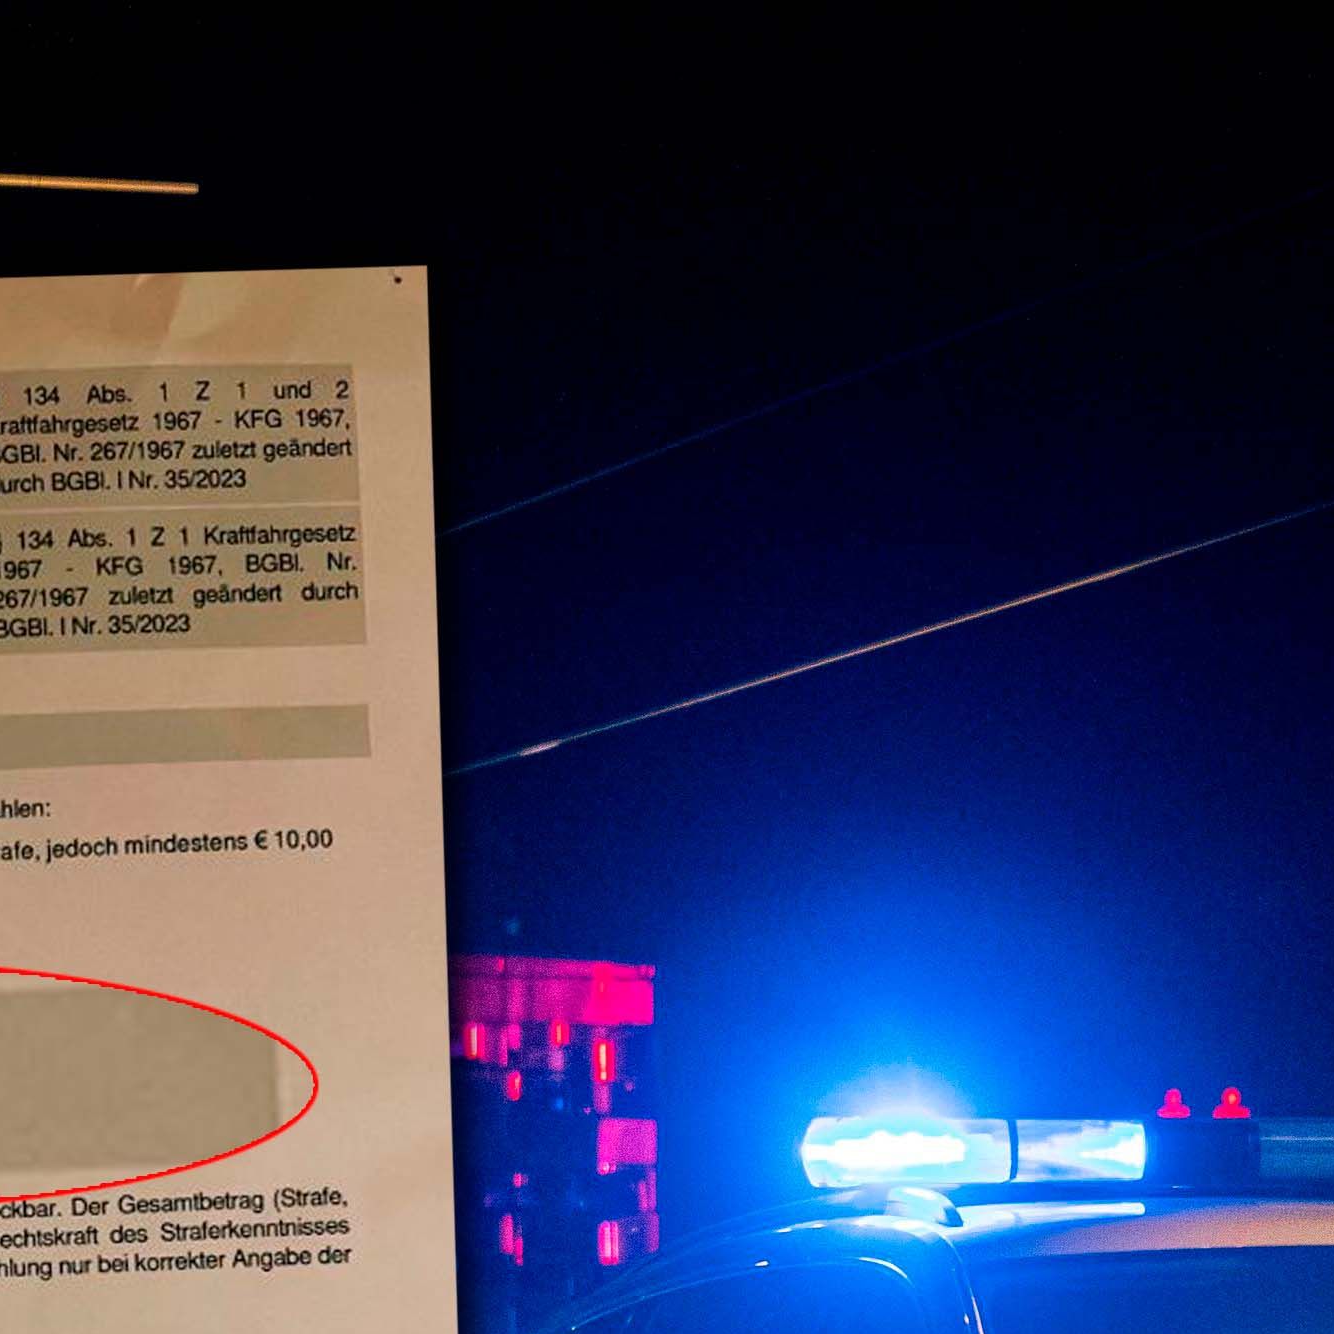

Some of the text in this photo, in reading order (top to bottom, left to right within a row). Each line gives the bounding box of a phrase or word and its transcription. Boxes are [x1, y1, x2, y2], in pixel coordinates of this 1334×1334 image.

[23, 385, 60, 406] 134
[86, 383, 133, 405] Abs.
[159, 381, 167, 402] 1
[195, 380, 210, 401] Z
[237, 381, 245, 399] 1
[273, 380, 312, 400] und
[335, 379, 349, 400] 2
[152, 410, 202, 431] 1967
[234, 407, 282, 429] KFG
[295, 407, 350, 429] 1967,
[53, 442, 83, 462] Nr.
[90, 439, 186, 462] 267/1967
[191, 439, 257, 460] zuletzt
[262, 436, 353, 462] geändert
[128, 469, 158, 490] Nr.
[163, 467, 247, 490] 35/2023
[16, 529, 54, 551] 134
[67, 527, 113, 548] Abs.
[127, 527, 136, 547] 1
[150, 525, 165, 547] Z
[179, 526, 188, 546] 1
[204, 524, 357, 548] Kraftfahrgesetz
[95, 555, 144, 577] KFG
[168, 554, 222, 577] 1967,
[326, 551, 357, 571] Nr.
[108, 585, 174, 605] zuletzt
[192, 582, 282, 609] geändert
[300, 580, 359, 601] durch
[71, 615, 102, 636] Nr.
[107, 612, 191, 635] 35/2023
[45, 836, 119, 864] jedoch
[124, 833, 248, 854] mindestens
[274, 828, 333, 851] 10,00
[109, 1224, 149, 1244] des
[160, 1217, 350, 1242] Straferkenntnisses
